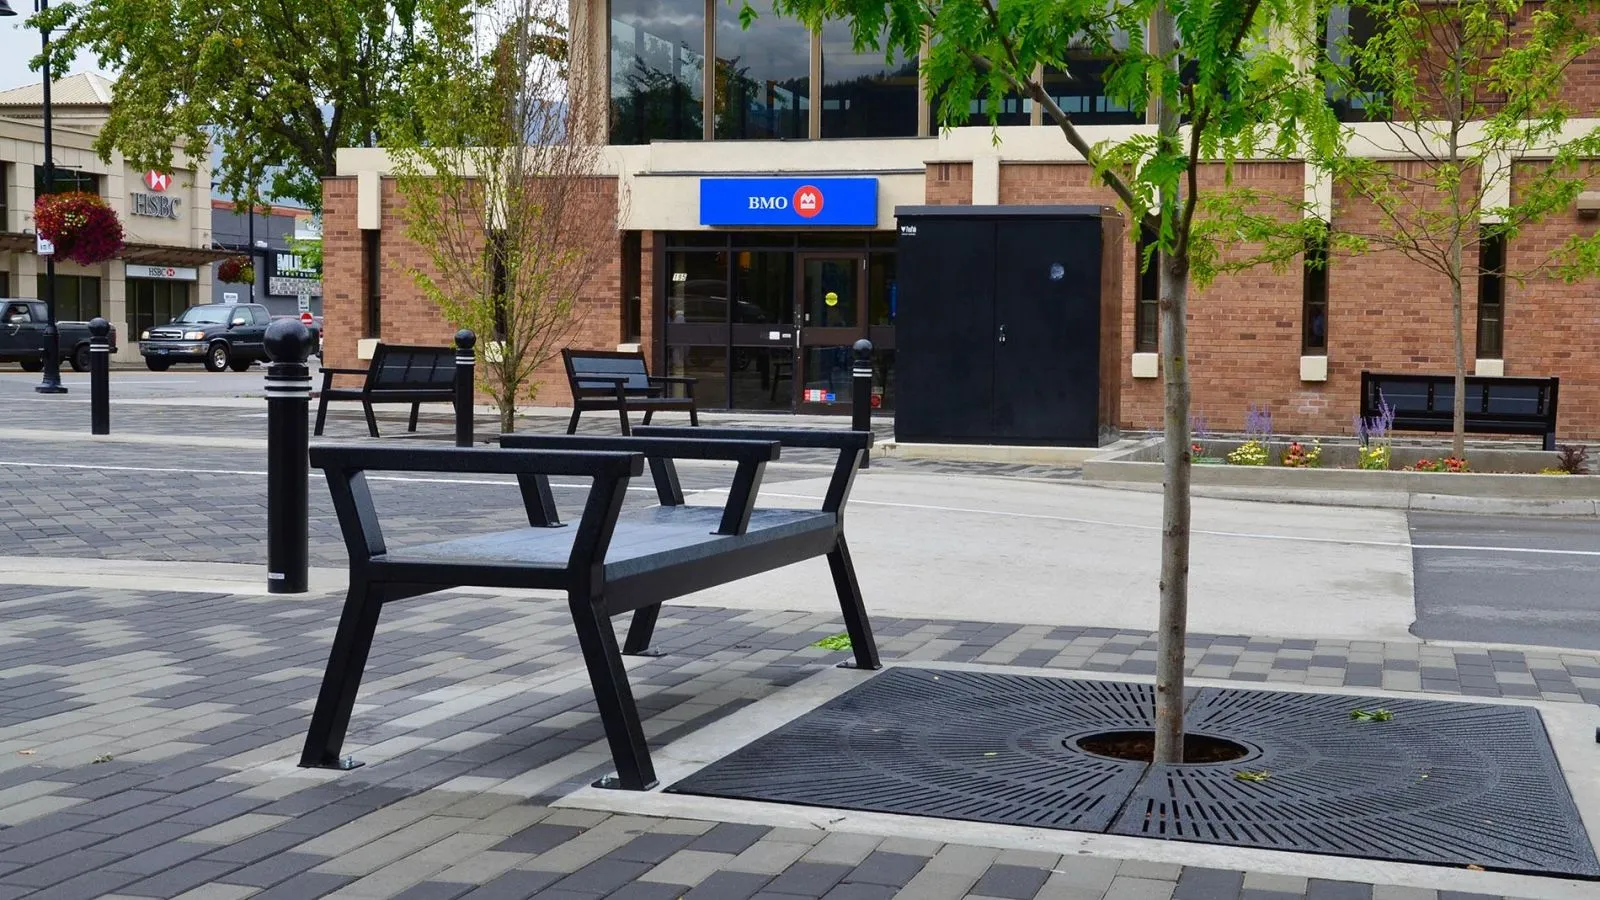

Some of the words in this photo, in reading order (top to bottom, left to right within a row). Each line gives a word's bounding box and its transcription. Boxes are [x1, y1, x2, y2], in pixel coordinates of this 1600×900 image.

[130, 191, 183, 220] HSBC
[748, 196, 788, 210] BMO
[148, 267, 166, 277] HSBC
